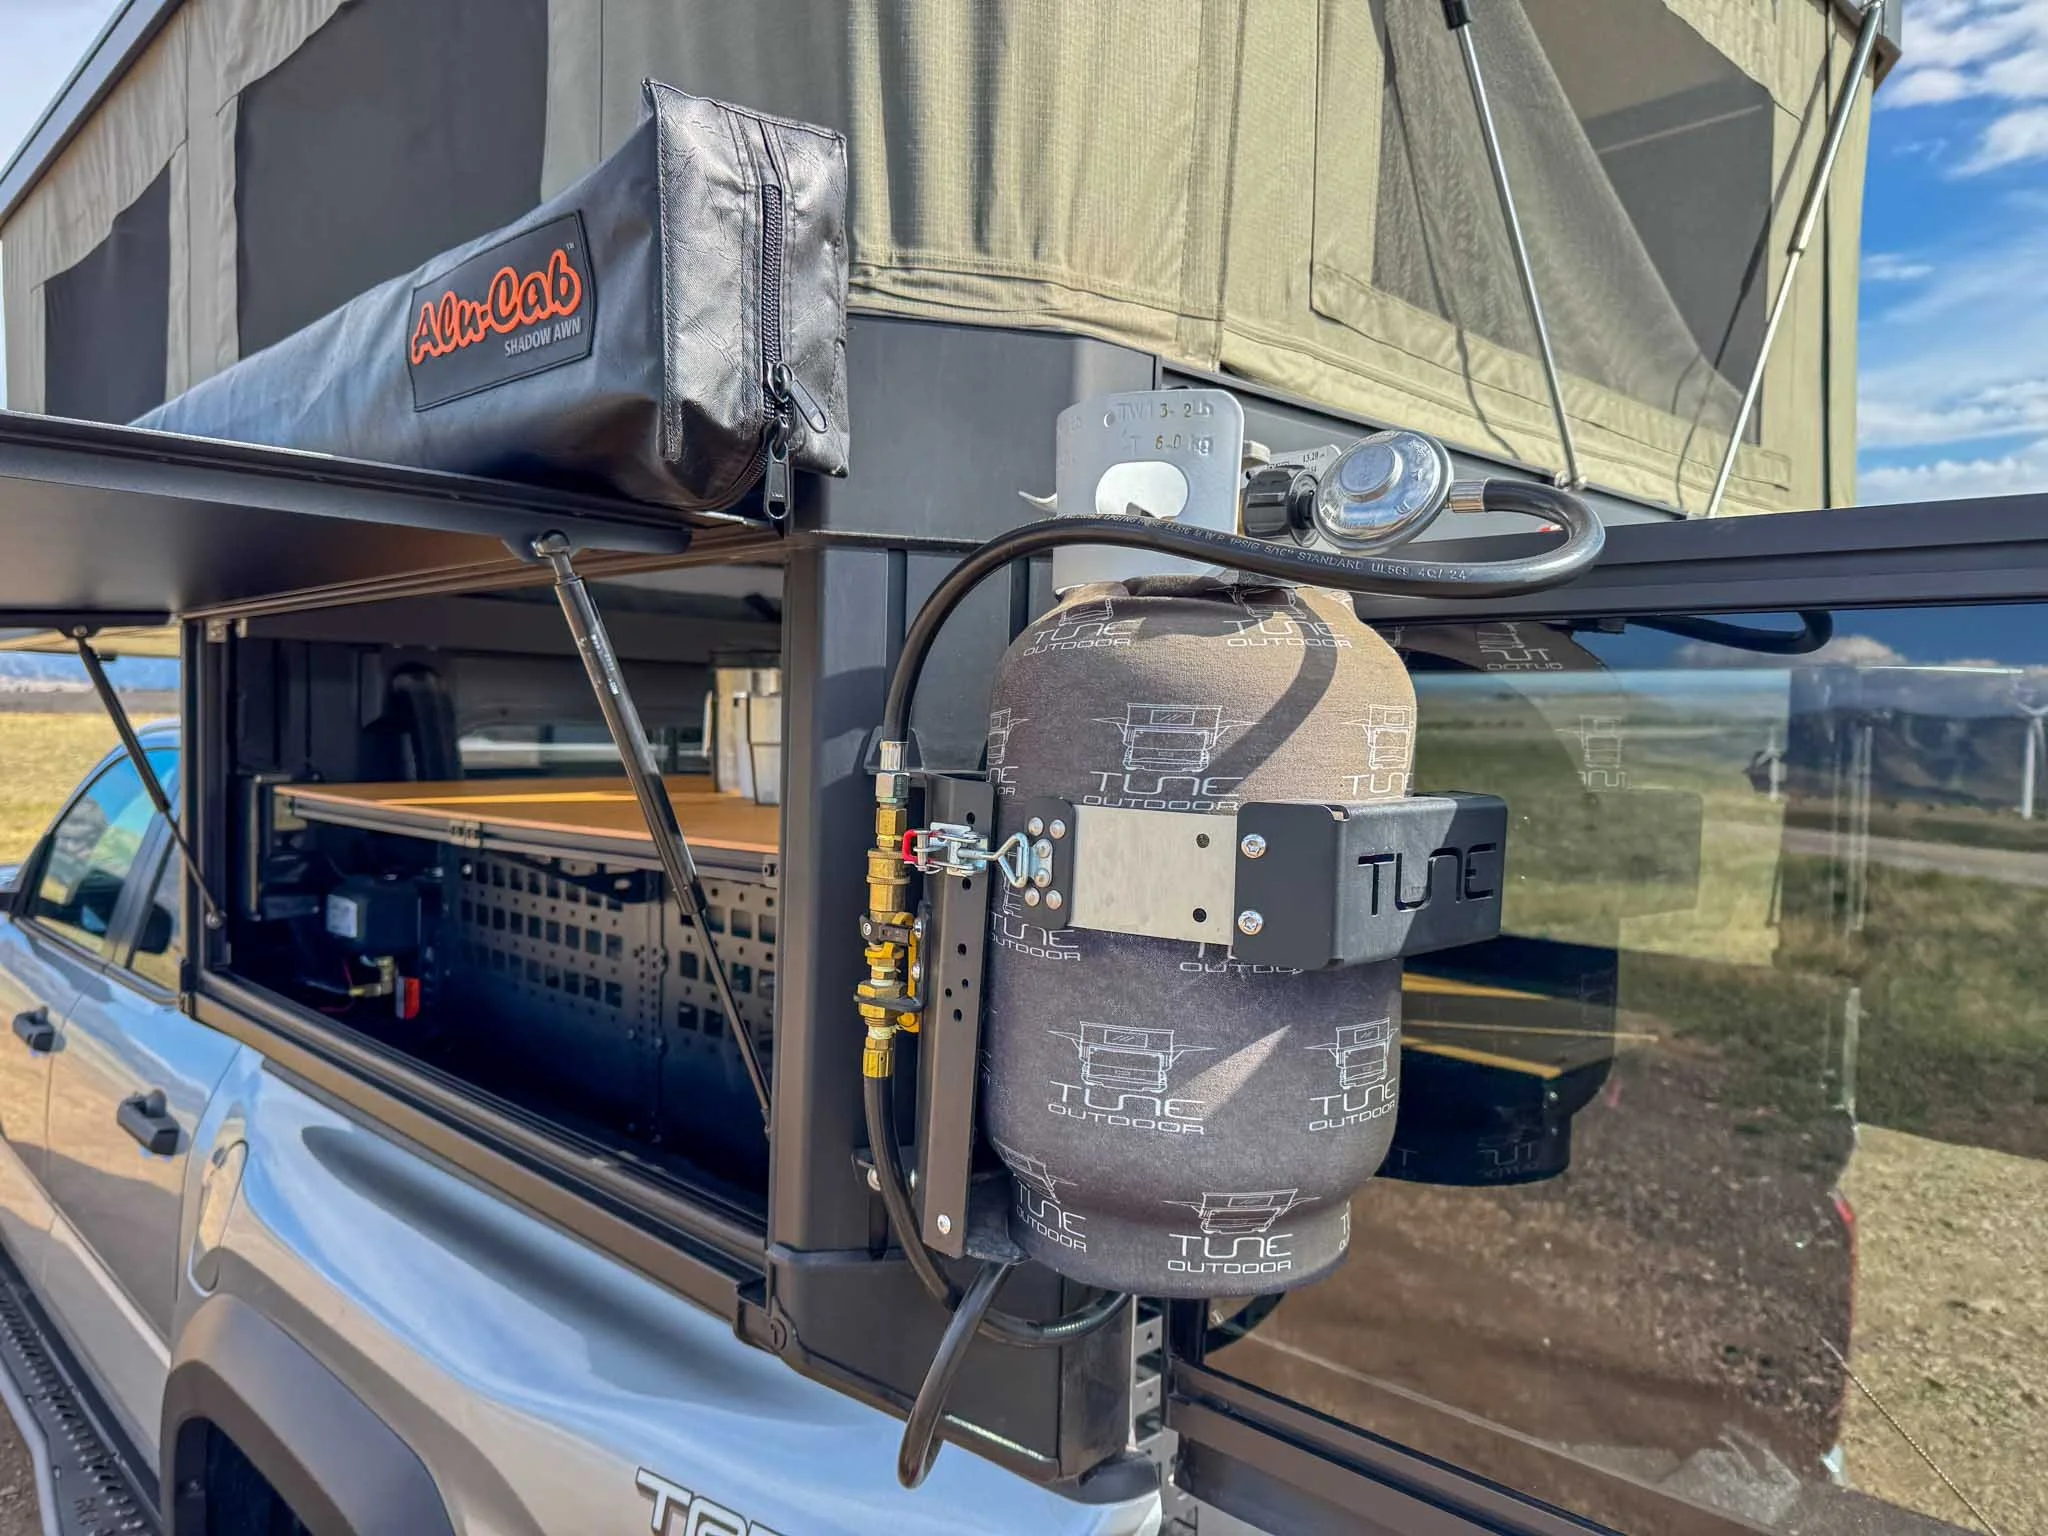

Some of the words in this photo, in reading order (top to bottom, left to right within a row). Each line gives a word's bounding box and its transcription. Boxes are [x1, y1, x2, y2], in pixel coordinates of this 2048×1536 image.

[411, 248, 582, 365] Alu-Cab
[504, 329, 551, 357] SHADOW
[553, 317, 582, 341] AWN
[1297, 551, 1363, 570] STANDARD
[1033, 620, 1138, 645] TUNE
[1223, 618, 1345, 637] TUNE
[1024, 638, 1131, 656] OUTDOOR
[1227, 637, 1353, 649] OUTDOOR
[986, 766, 1019, 783] NE
[1090, 770, 1244, 797] TUNE
[1083, 795, 1239, 811] OUTDOOR
[1358, 842, 1497, 917] TUNE
[992, 911, 1079, 948] TUNE
[1049, 1080, 1205, 1121] TUNE
[1309, 1077, 1396, 1115] TUNE
[1048, 1103, 1205, 1135] OUTDOOR
[1309, 1099, 1395, 1131] OUTDOOR
[1017, 1179, 1087, 1238] TUNE
[1168, 1233, 1293, 1258] TUNE
[1167, 1260, 1292, 1273] OUTDOOR
